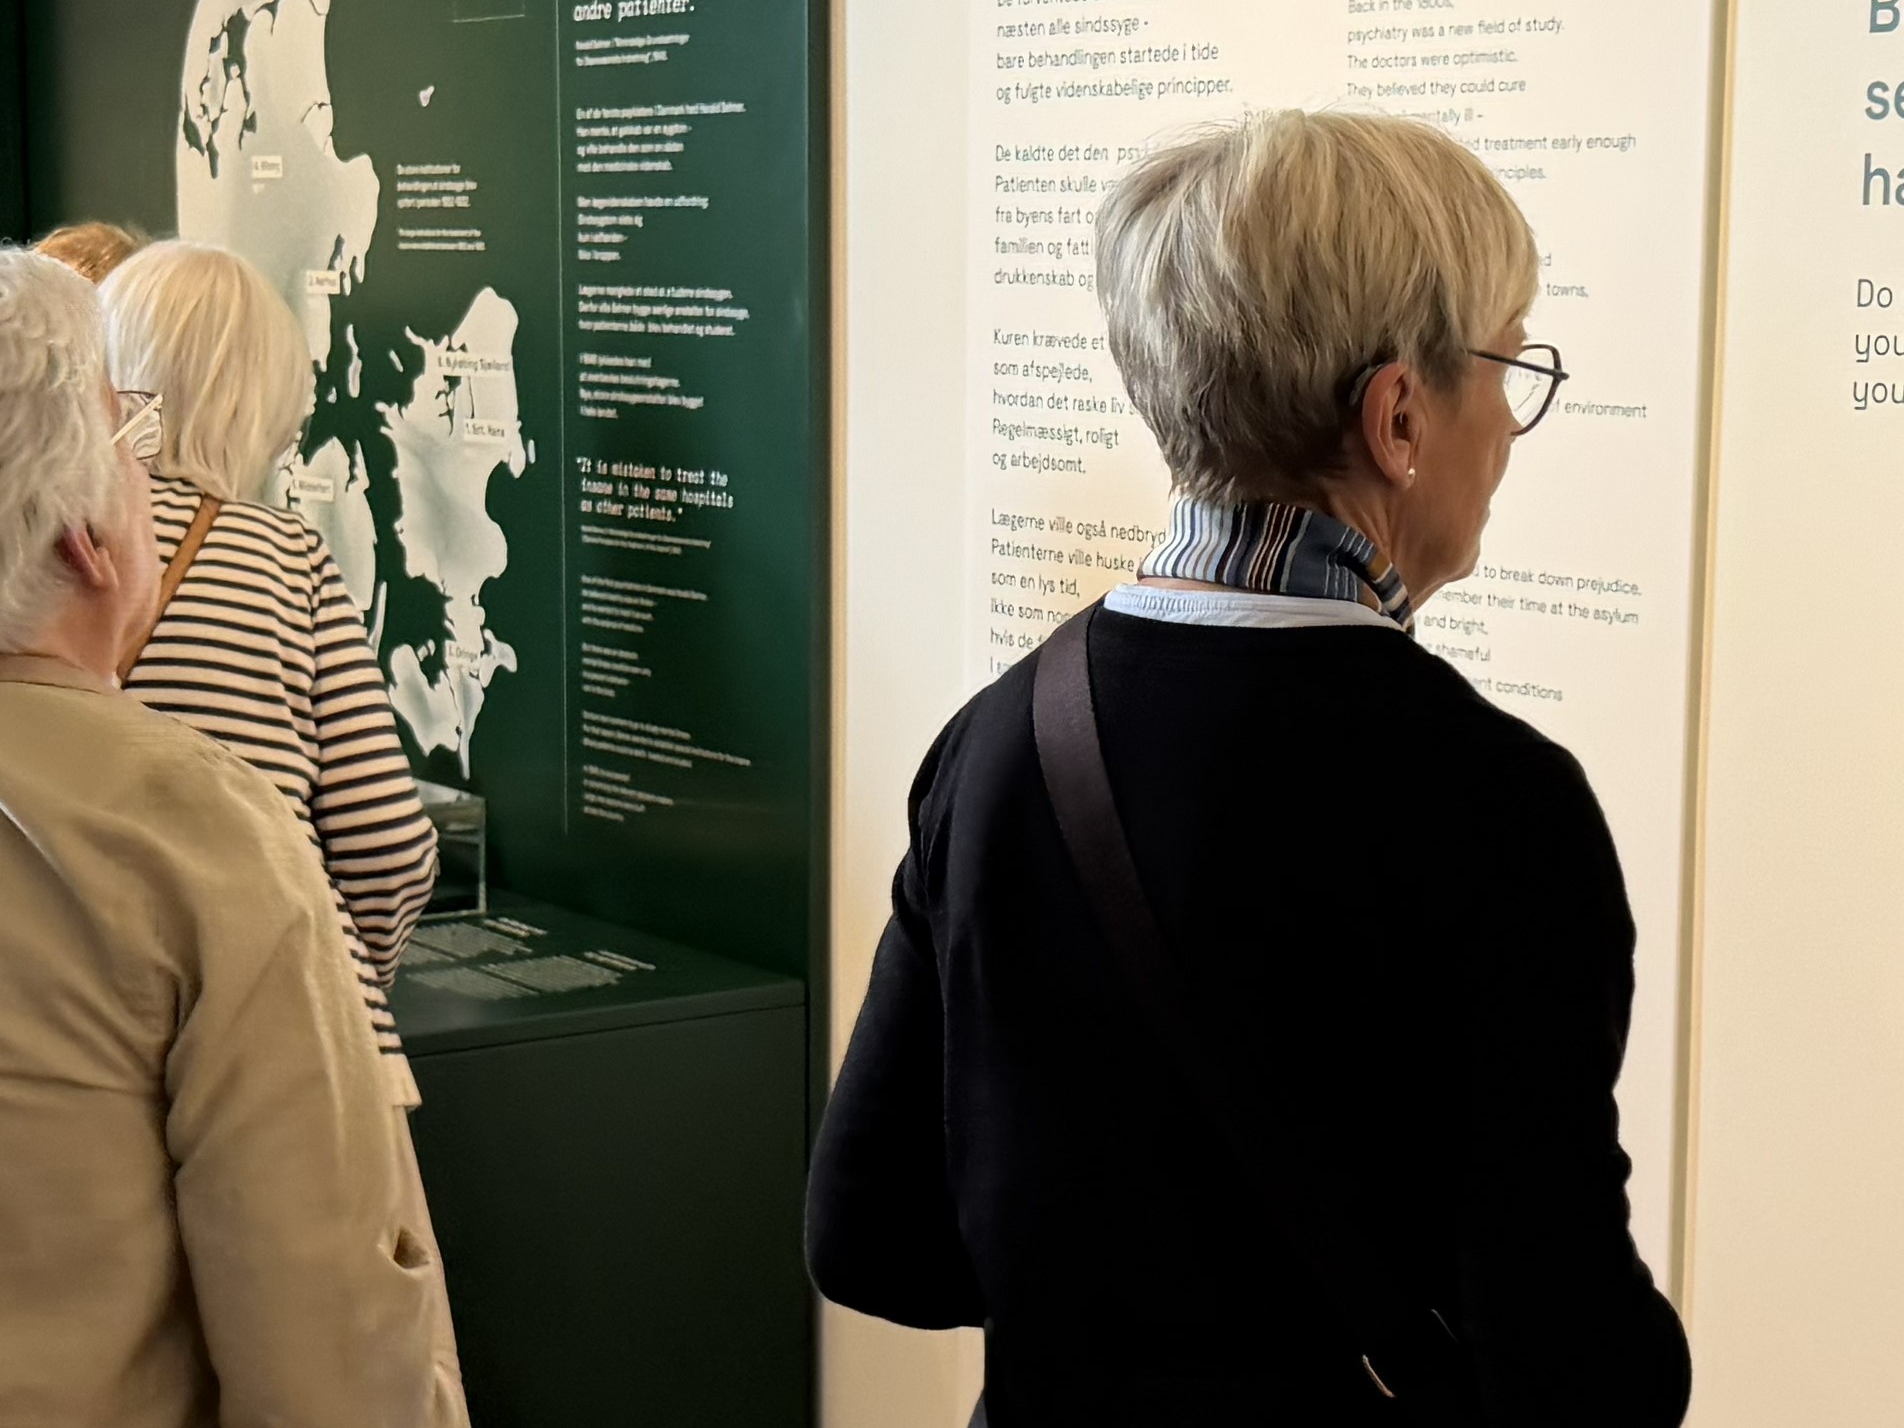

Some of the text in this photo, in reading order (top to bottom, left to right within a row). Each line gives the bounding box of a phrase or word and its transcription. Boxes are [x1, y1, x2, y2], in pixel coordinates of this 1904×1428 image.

[573, 0, 612, 21] andre
[997, 16, 1139, 37] næsten sindssyge
[1348, 26, 1434, 44] psychiatry was
[997, 42, 1218, 69] bare behandlingen startede tide
[1348, 54, 1449, 69] The doctors were
[997, 77, 1233, 105] og fulgte videnskabelige principper.
[1378, 79, 1526, 97] believed they could cure
[996, 144, 1108, 162] De kaldte det den
[1484, 136, 1547, 151] treatment
[1552, 135, 1582, 152] early
[1587, 135, 1636, 152] enough
[996, 176, 1056, 192] Patienten
[1060, 175, 1096, 192] skulle
[996, 206, 1081, 227] fra byens fart
[995, 237, 1063, 259] familien og
[995, 269, 1074, 286] drukkenskab
[1857, 279, 1894, 309] Do
[994, 329, 1104, 350] Kuren krævede et
[994, 362, 1019, 375] som
[993, 389, 1107, 412] hvordan det raske
[1565, 401, 1647, 418] environment
[1086, 428, 1119, 449] roligt
[993, 452, 1007, 470] og
[992, 508, 1106, 540] Lægerne også
[992, 539, 1135, 572] Patienterne huske
[992, 573, 1035, 590] som en
[1500, 567, 1642, 596] break prejudice.
[991, 598, 1043, 621] Ikke som
[1520, 598, 1638, 625] time the asylum
[1496, 680, 1562, 701] conditions
